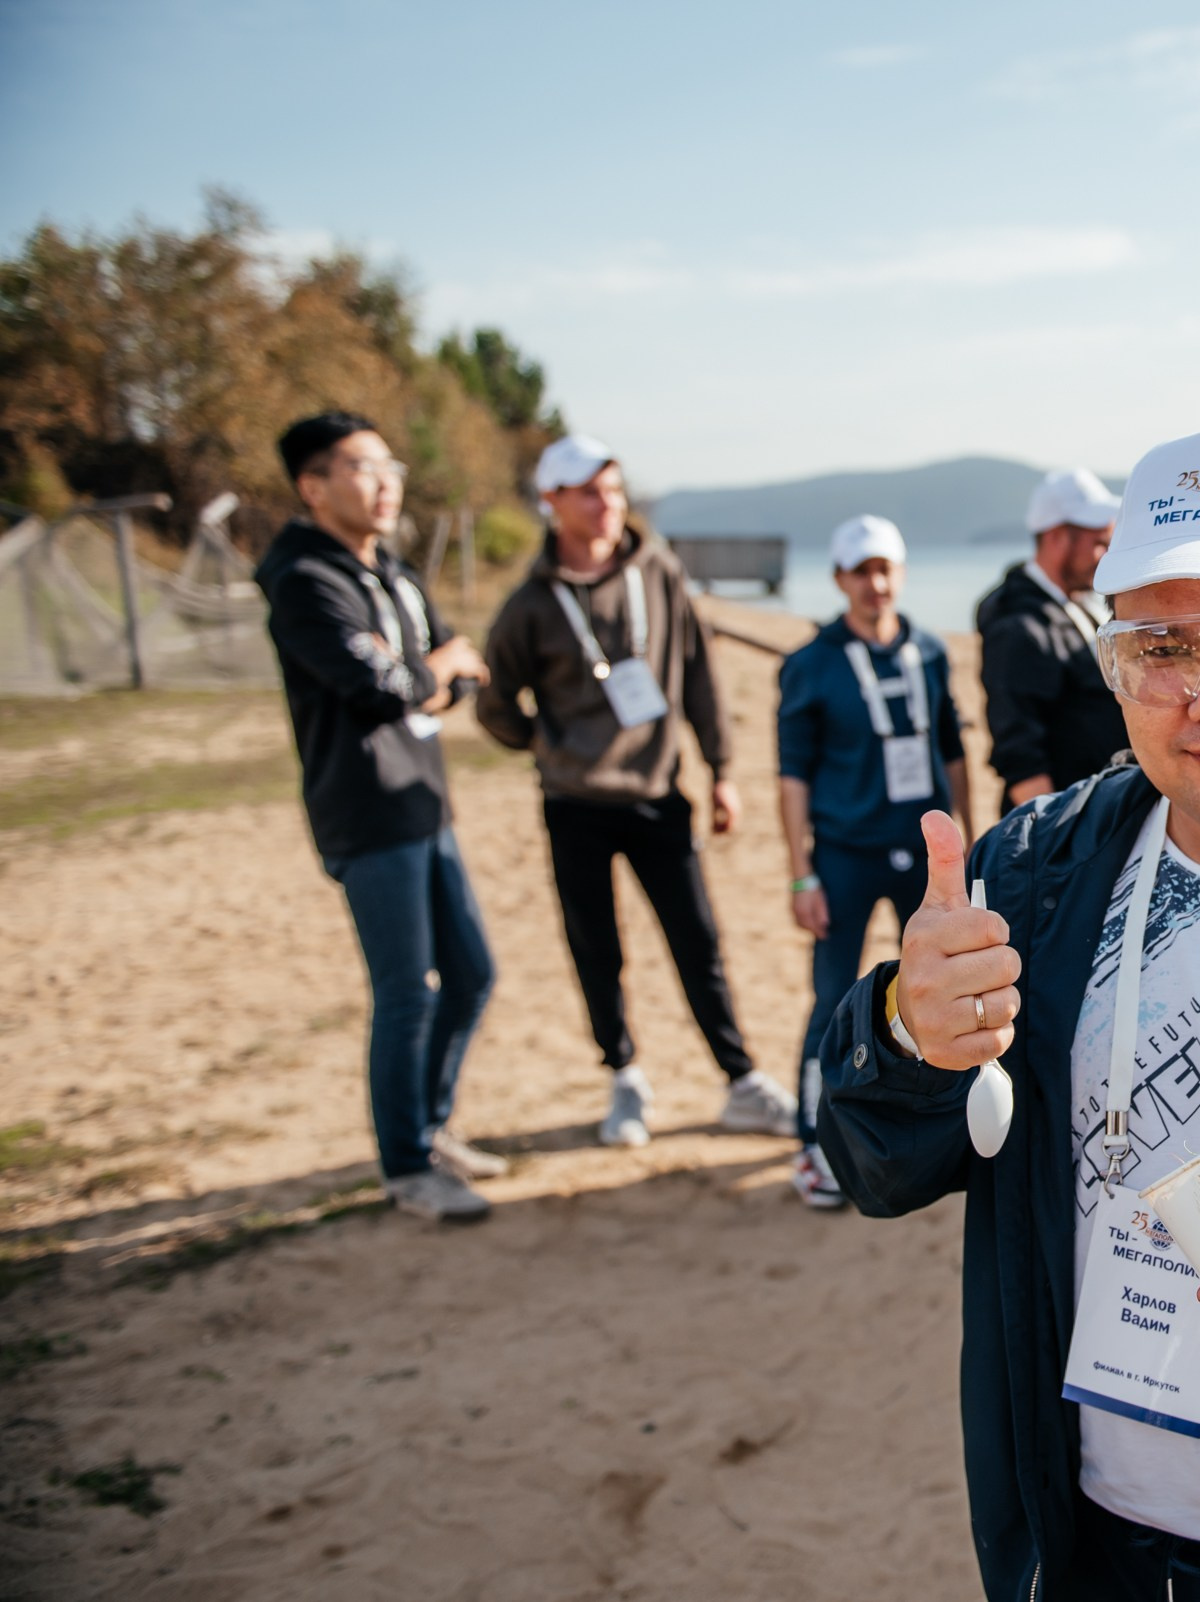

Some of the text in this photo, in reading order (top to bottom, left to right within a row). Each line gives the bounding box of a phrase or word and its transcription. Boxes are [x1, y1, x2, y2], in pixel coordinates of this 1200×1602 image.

[1176, 470, 1200, 490] 25
[1148, 496, 1174, 512] ТЫ
[1131, 1210, 1149, 1231] 25
[1108, 1226, 1129, 1243] ТЫ
[1112, 1245, 1200, 1280] МЕГАПОЛИ
[1121, 1286, 1177, 1315] Харлов
[1121, 1307, 1171, 1335] Вадим
[1093, 1361, 1125, 1378] филиал
[1143, 1375, 1181, 1394] Иркутск
